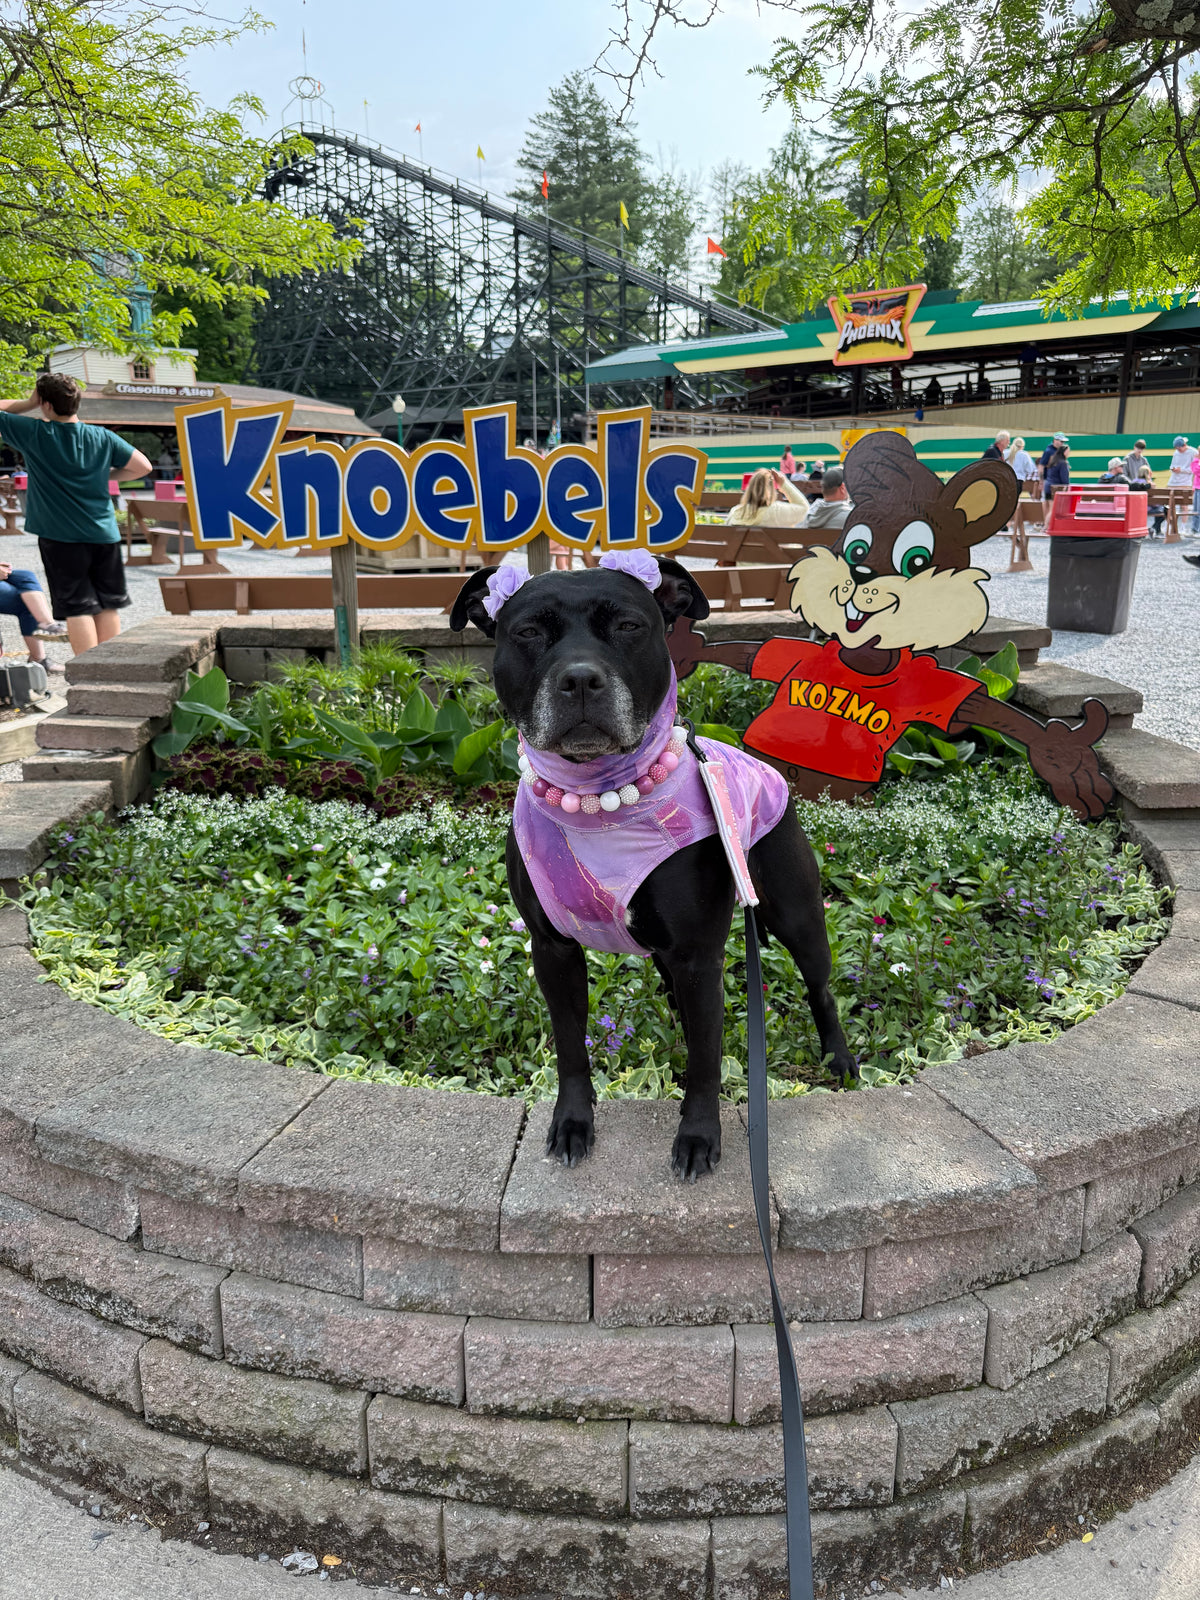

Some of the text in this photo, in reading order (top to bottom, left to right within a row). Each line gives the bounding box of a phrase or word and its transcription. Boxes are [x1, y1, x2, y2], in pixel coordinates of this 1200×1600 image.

[837, 319, 905, 351] PHOENIX
[115, 383, 214, 398] Gasoline Alley
[183, 406, 699, 546] Knoebels
[789, 679, 891, 734] KOZMO
